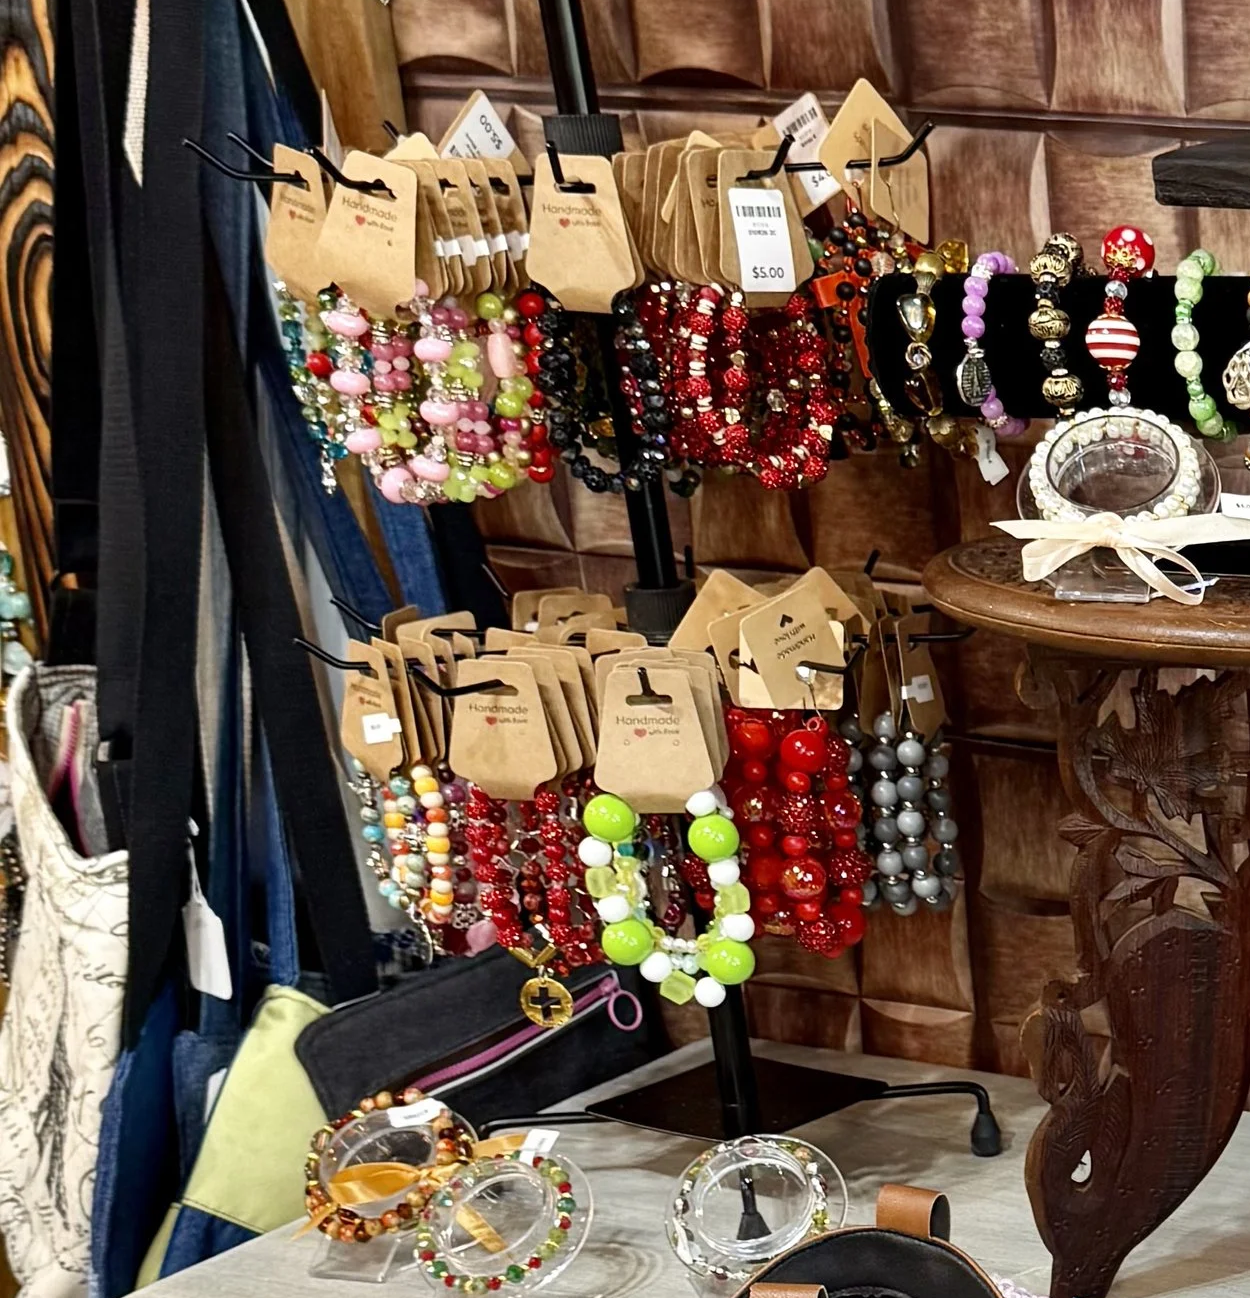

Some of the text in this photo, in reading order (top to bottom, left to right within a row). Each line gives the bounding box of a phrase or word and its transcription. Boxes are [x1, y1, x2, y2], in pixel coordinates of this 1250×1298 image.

[341, 196, 398, 222] Handmade
[542, 203, 602, 217] Handmade
[752, 266, 785, 279] $5.00
[777, 633, 816, 660] Handmade
[469, 703, 529, 715] Handmade
[616, 715, 680, 726] Handmade
